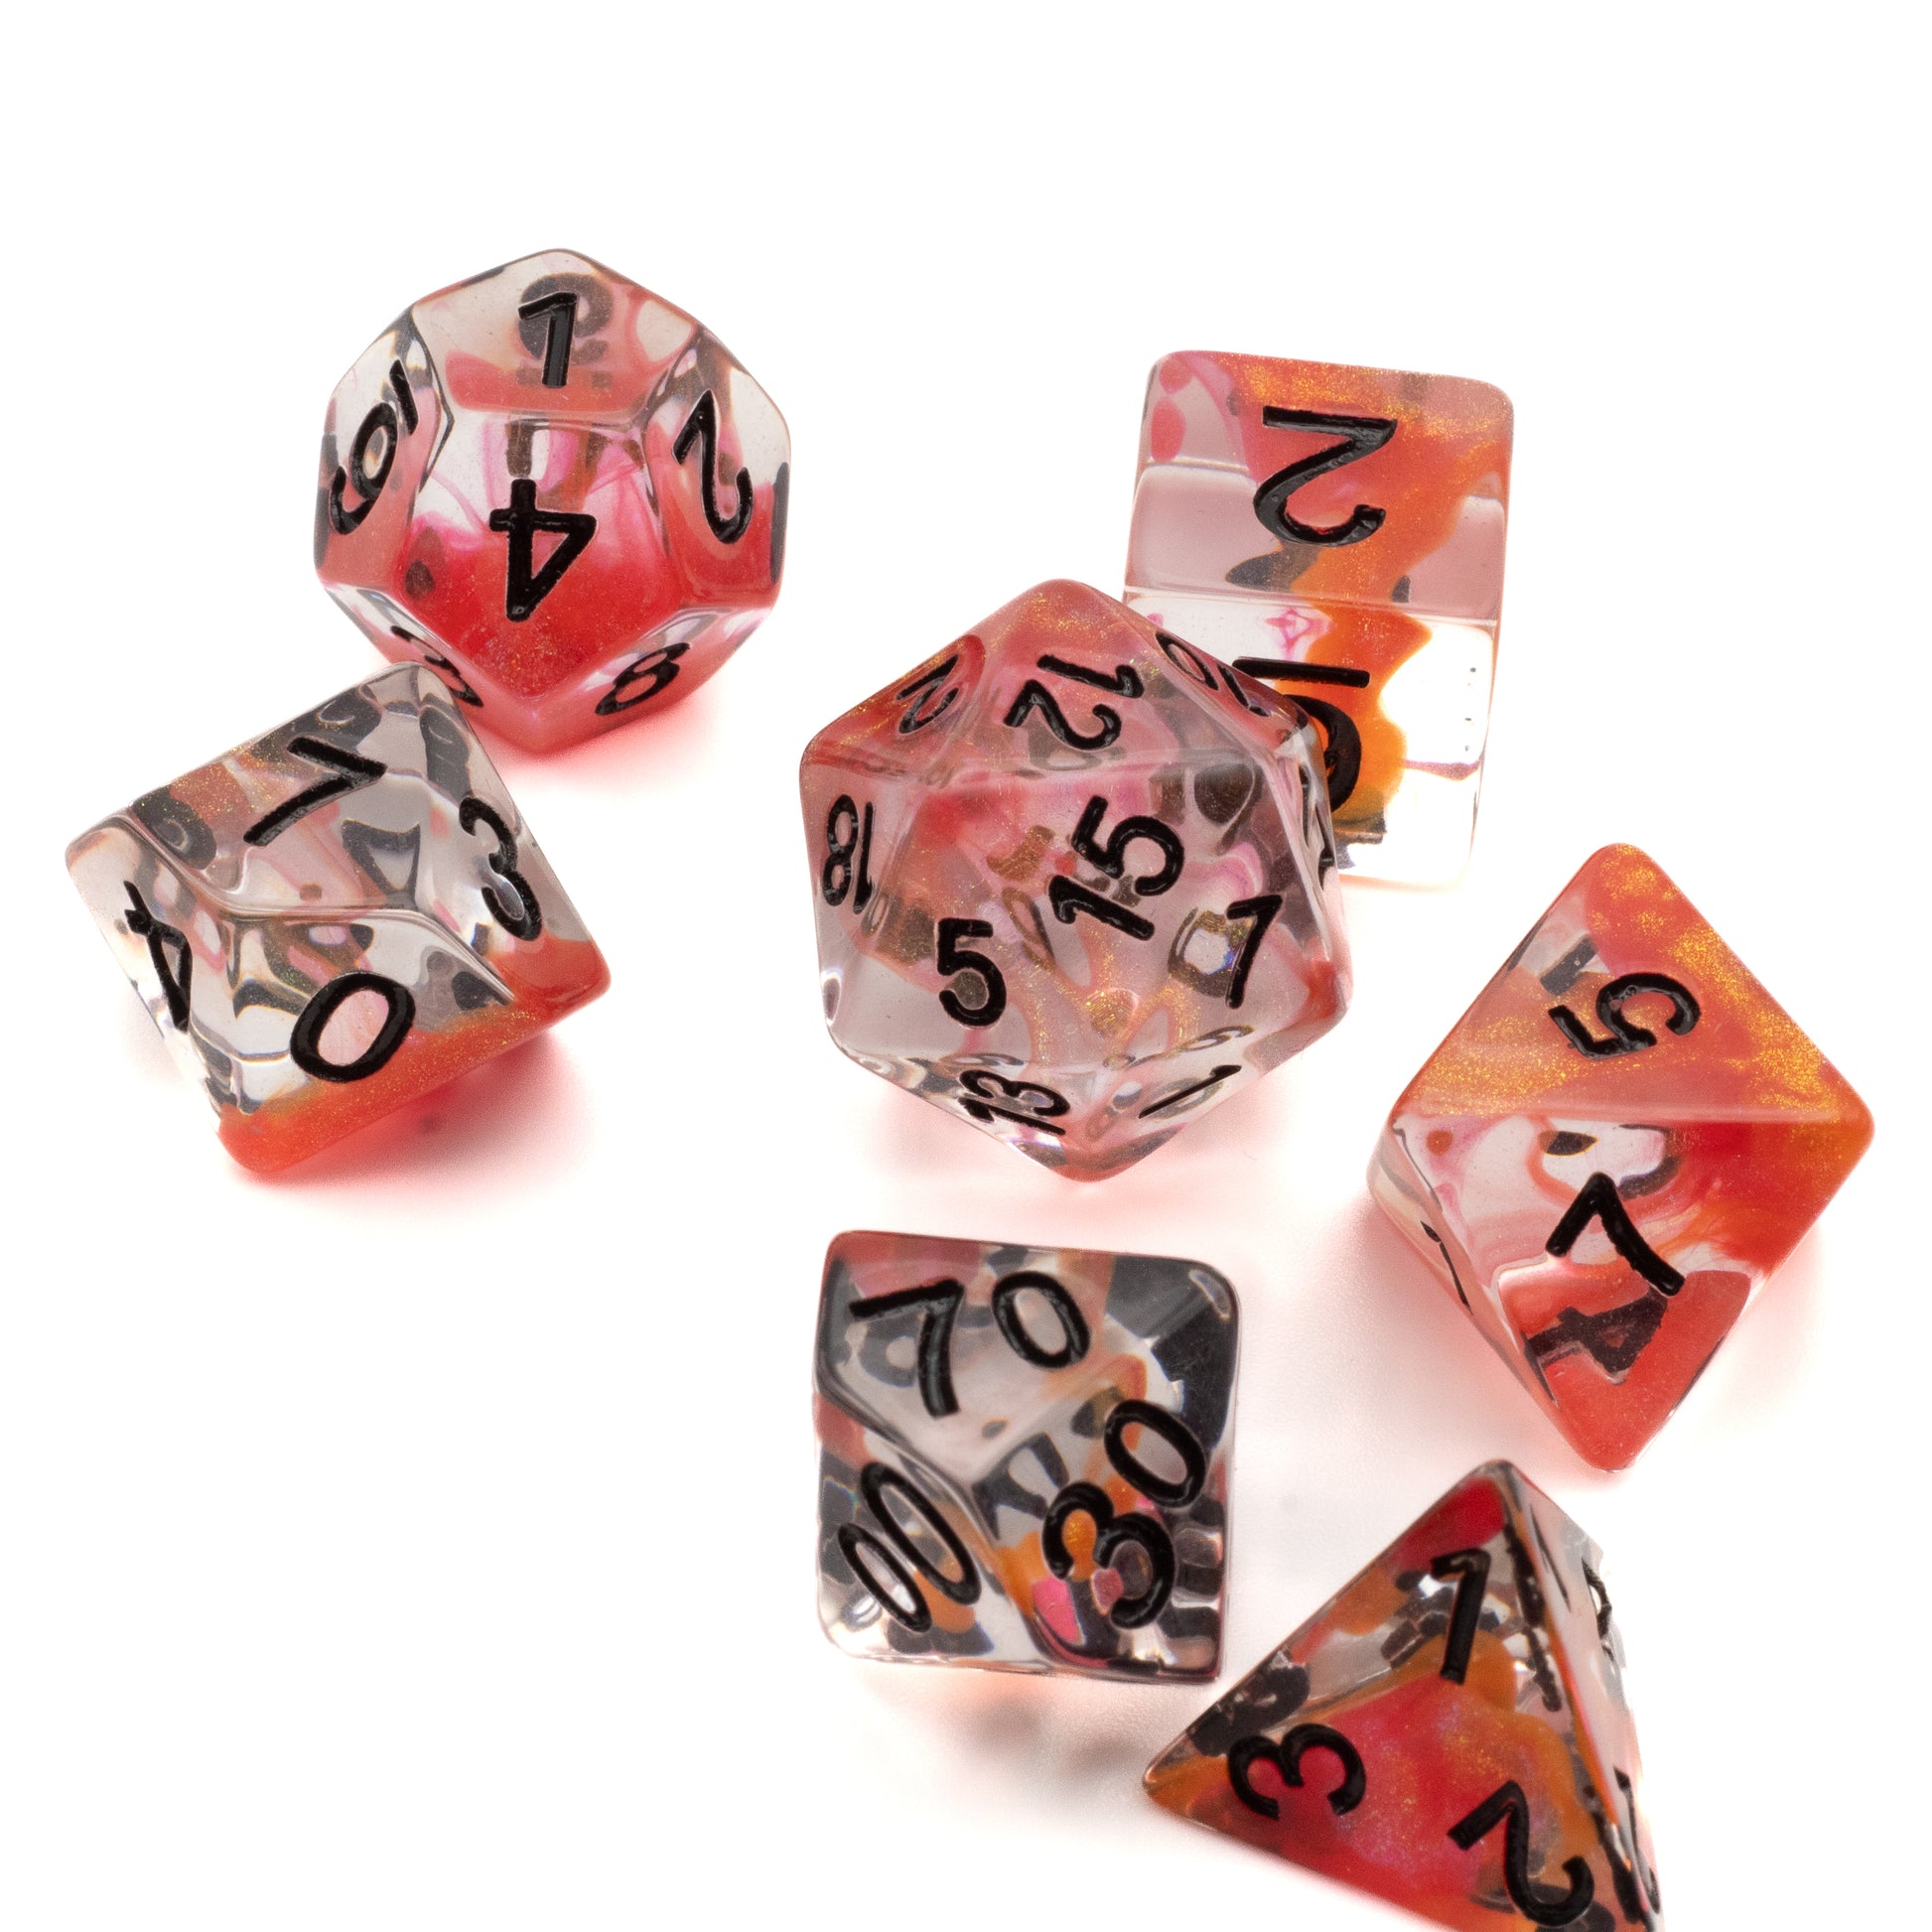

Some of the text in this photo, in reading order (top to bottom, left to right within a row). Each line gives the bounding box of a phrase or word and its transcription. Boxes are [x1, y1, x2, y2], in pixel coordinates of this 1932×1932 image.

[517, 291, 578, 387] 1
[672, 389, 754, 544] 2
[1253, 406, 1398, 547] 2
[489, 479, 596, 622] 4
[596, 642, 690, 716] 8
[897, 654, 959, 735] 2
[1004, 655, 1145, 752] 12
[243, 737, 387, 847] 7
[460, 797, 543, 941] 3
[823, 795, 877, 914] 18
[1049, 795, 1184, 940] 15
[124, 881, 193, 1033] 4
[937, 918, 1008, 1027] 5
[1226, 894, 1283, 1009] 7
[290, 971, 415, 1083] 0
[1548, 973, 1702, 1059] 5
[956, 1069, 1071, 1136] 13
[1546, 1173, 1685, 1298] 7
[837, 1461, 982, 1632] 00
[1042, 1399, 1206, 1629] 30
[1431, 1548, 1492, 1685] 1
[1227, 1724, 1367, 1820] 3
[1448, 1781, 1594, 1927] 2
